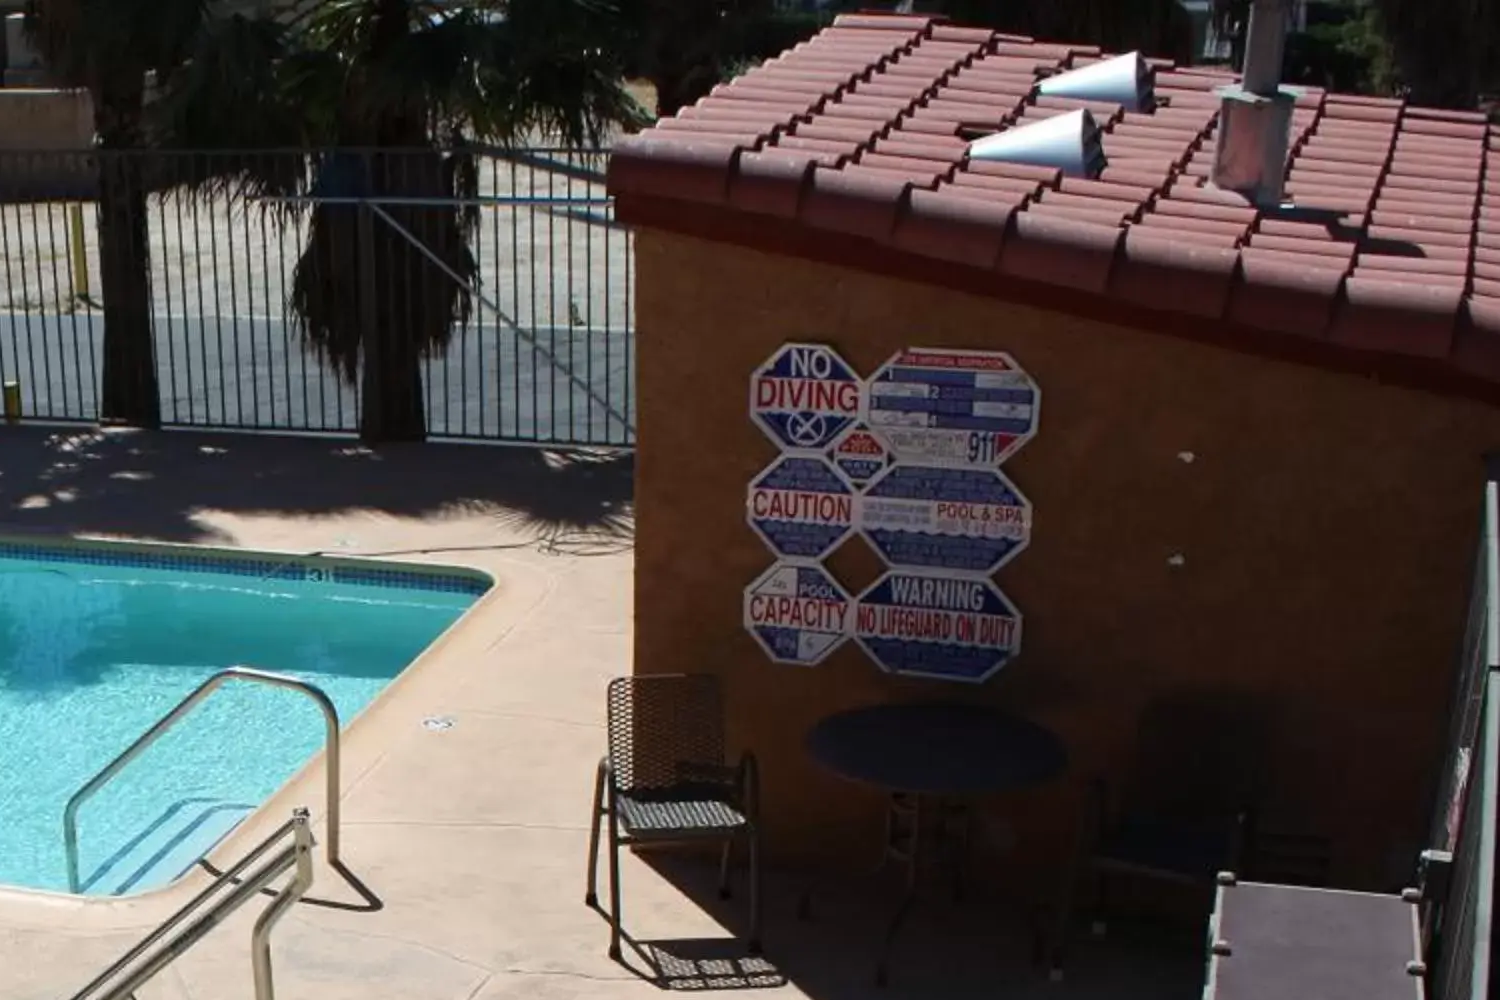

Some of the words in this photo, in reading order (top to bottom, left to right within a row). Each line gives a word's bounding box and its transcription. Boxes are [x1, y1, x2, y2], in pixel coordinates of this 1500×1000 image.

[790, 348, 832, 379] NO
[757, 379, 859, 412] DIVING
[930, 385, 941, 399] 2
[968, 432, 997, 463] 911
[753, 491, 852, 522] CAUTION
[937, 503, 979, 520] POOL
[981, 507, 991, 521] &
[994, 508, 1024, 524] SPA
[799, 583, 837, 599] POOL
[890, 575, 986, 611] WARNING
[750, 595, 848, 631] CAPACITY
[856, 606, 876, 633] NO
[879, 608, 951, 639] LIFEGUARD
[956, 614, 976, 641] ON
[980, 617, 1016, 647] DUTY
